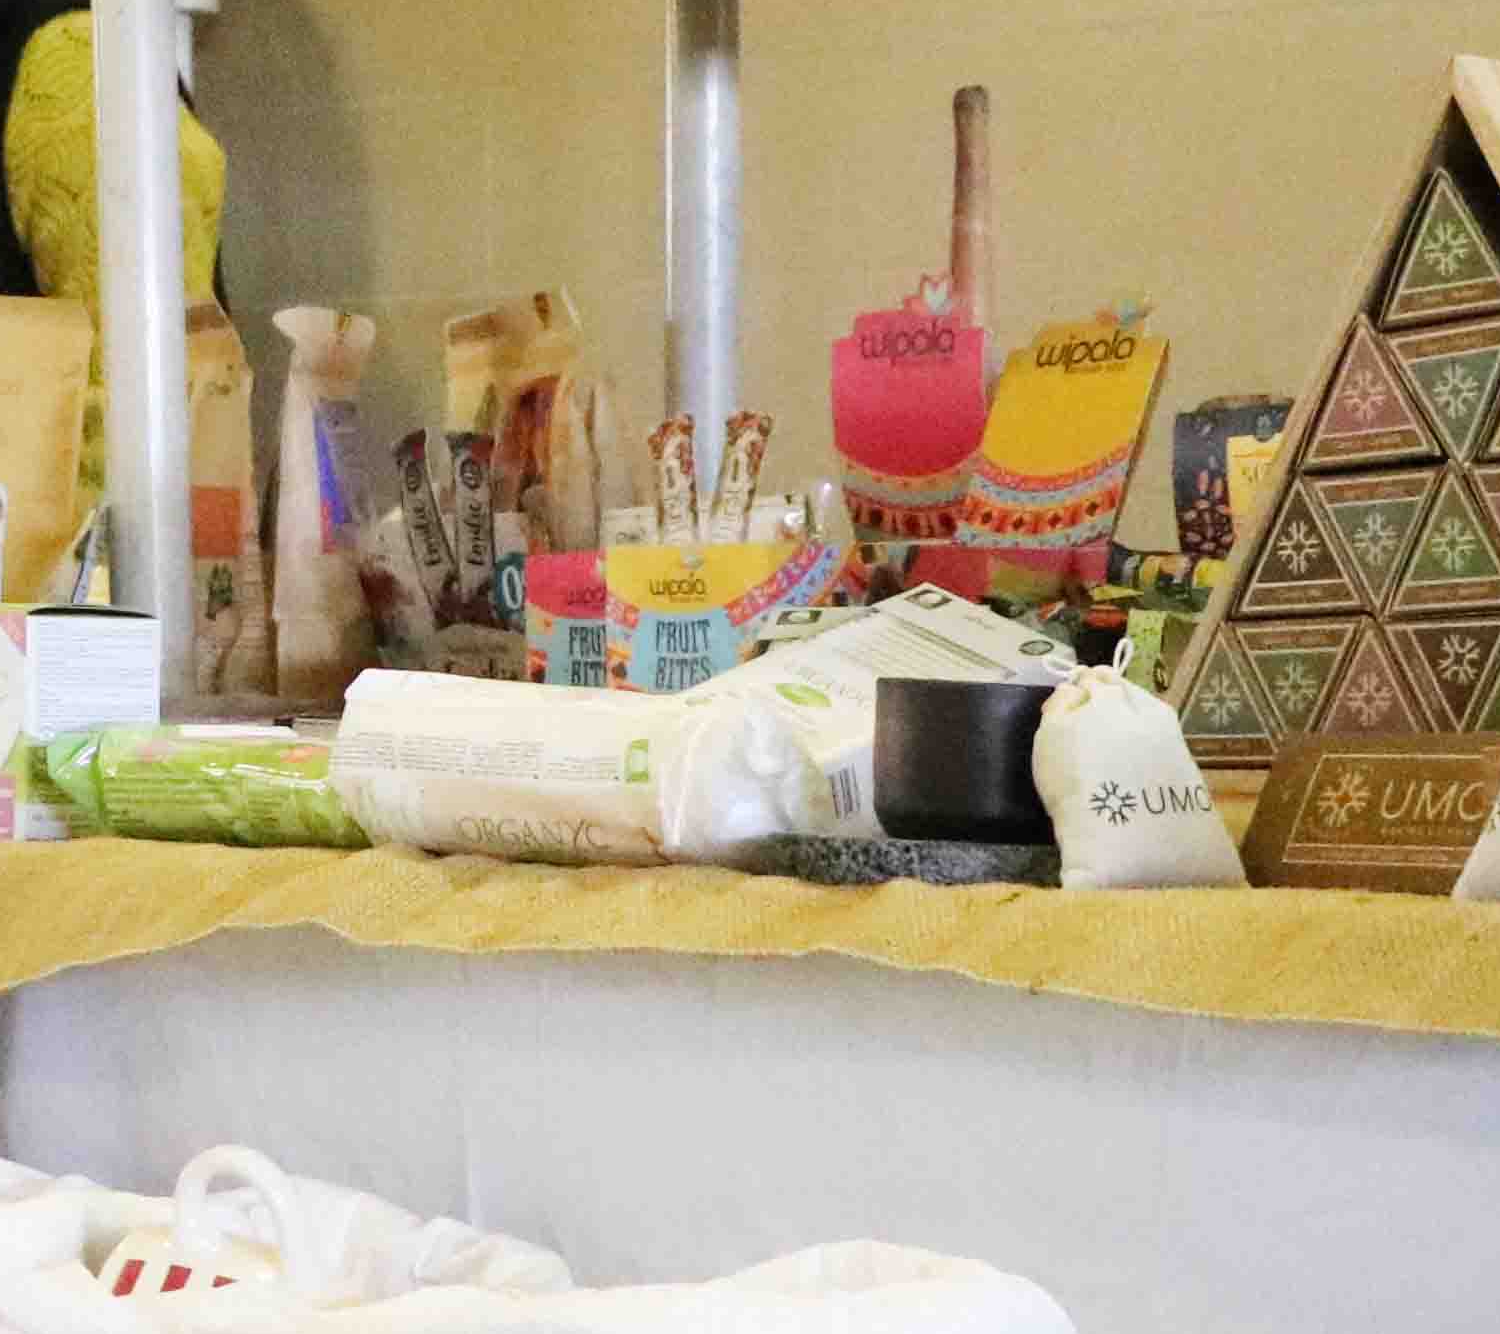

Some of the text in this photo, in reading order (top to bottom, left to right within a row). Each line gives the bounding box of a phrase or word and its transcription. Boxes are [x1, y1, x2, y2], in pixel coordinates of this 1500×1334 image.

[1036, 330, 1136, 373] wipala
[655, 618, 711, 654] FRUIT
[654, 657, 713, 690] BITES
